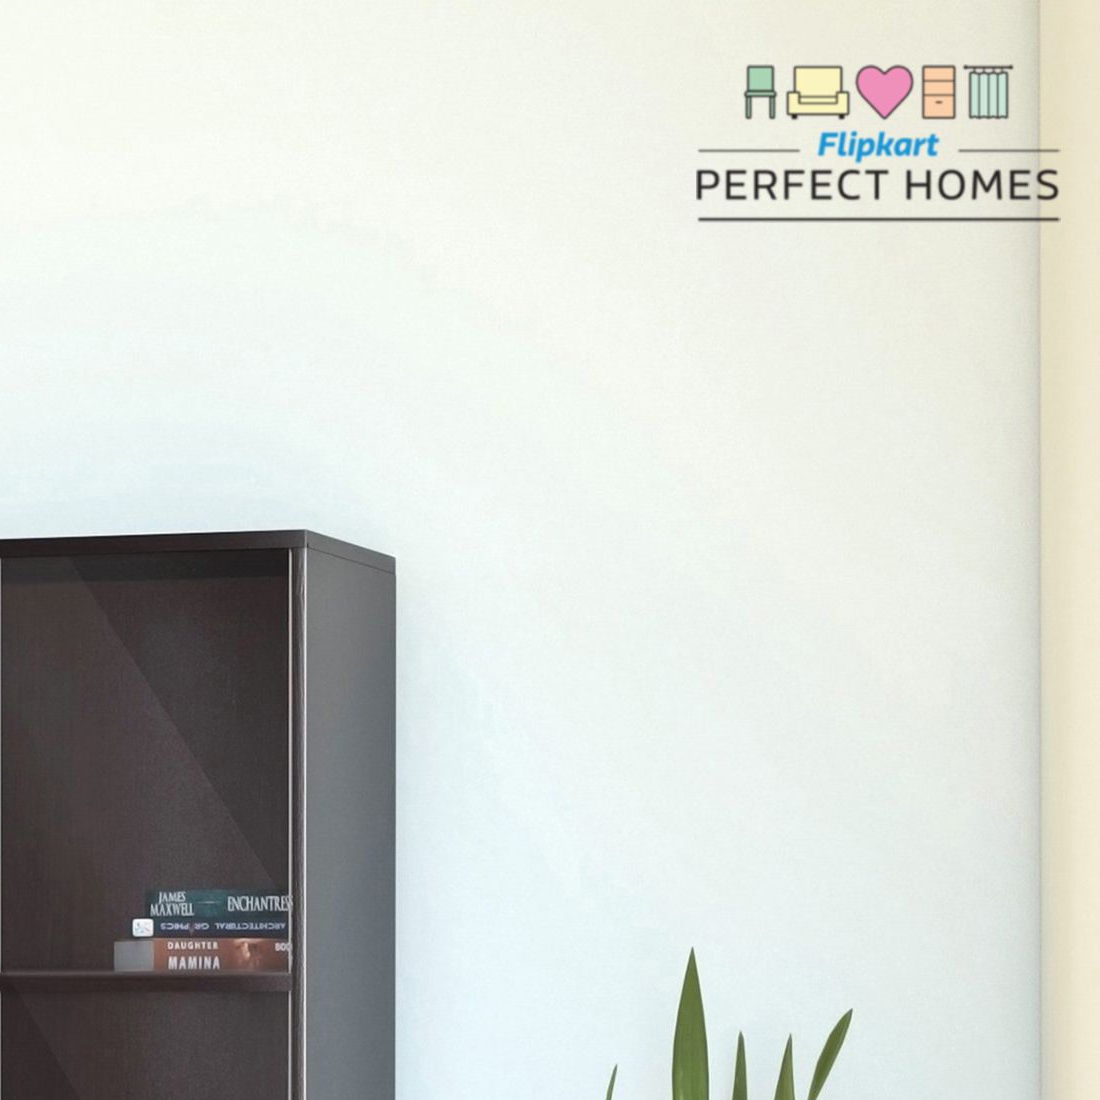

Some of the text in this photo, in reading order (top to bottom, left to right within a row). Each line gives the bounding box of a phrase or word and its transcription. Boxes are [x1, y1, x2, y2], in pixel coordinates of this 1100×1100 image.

[158, 891, 187, 904] JAMES
[150, 902, 195, 917] MAXWELL
[167, 941, 219, 950] DAUGHTER
[167, 956, 220, 970] MAMINA
